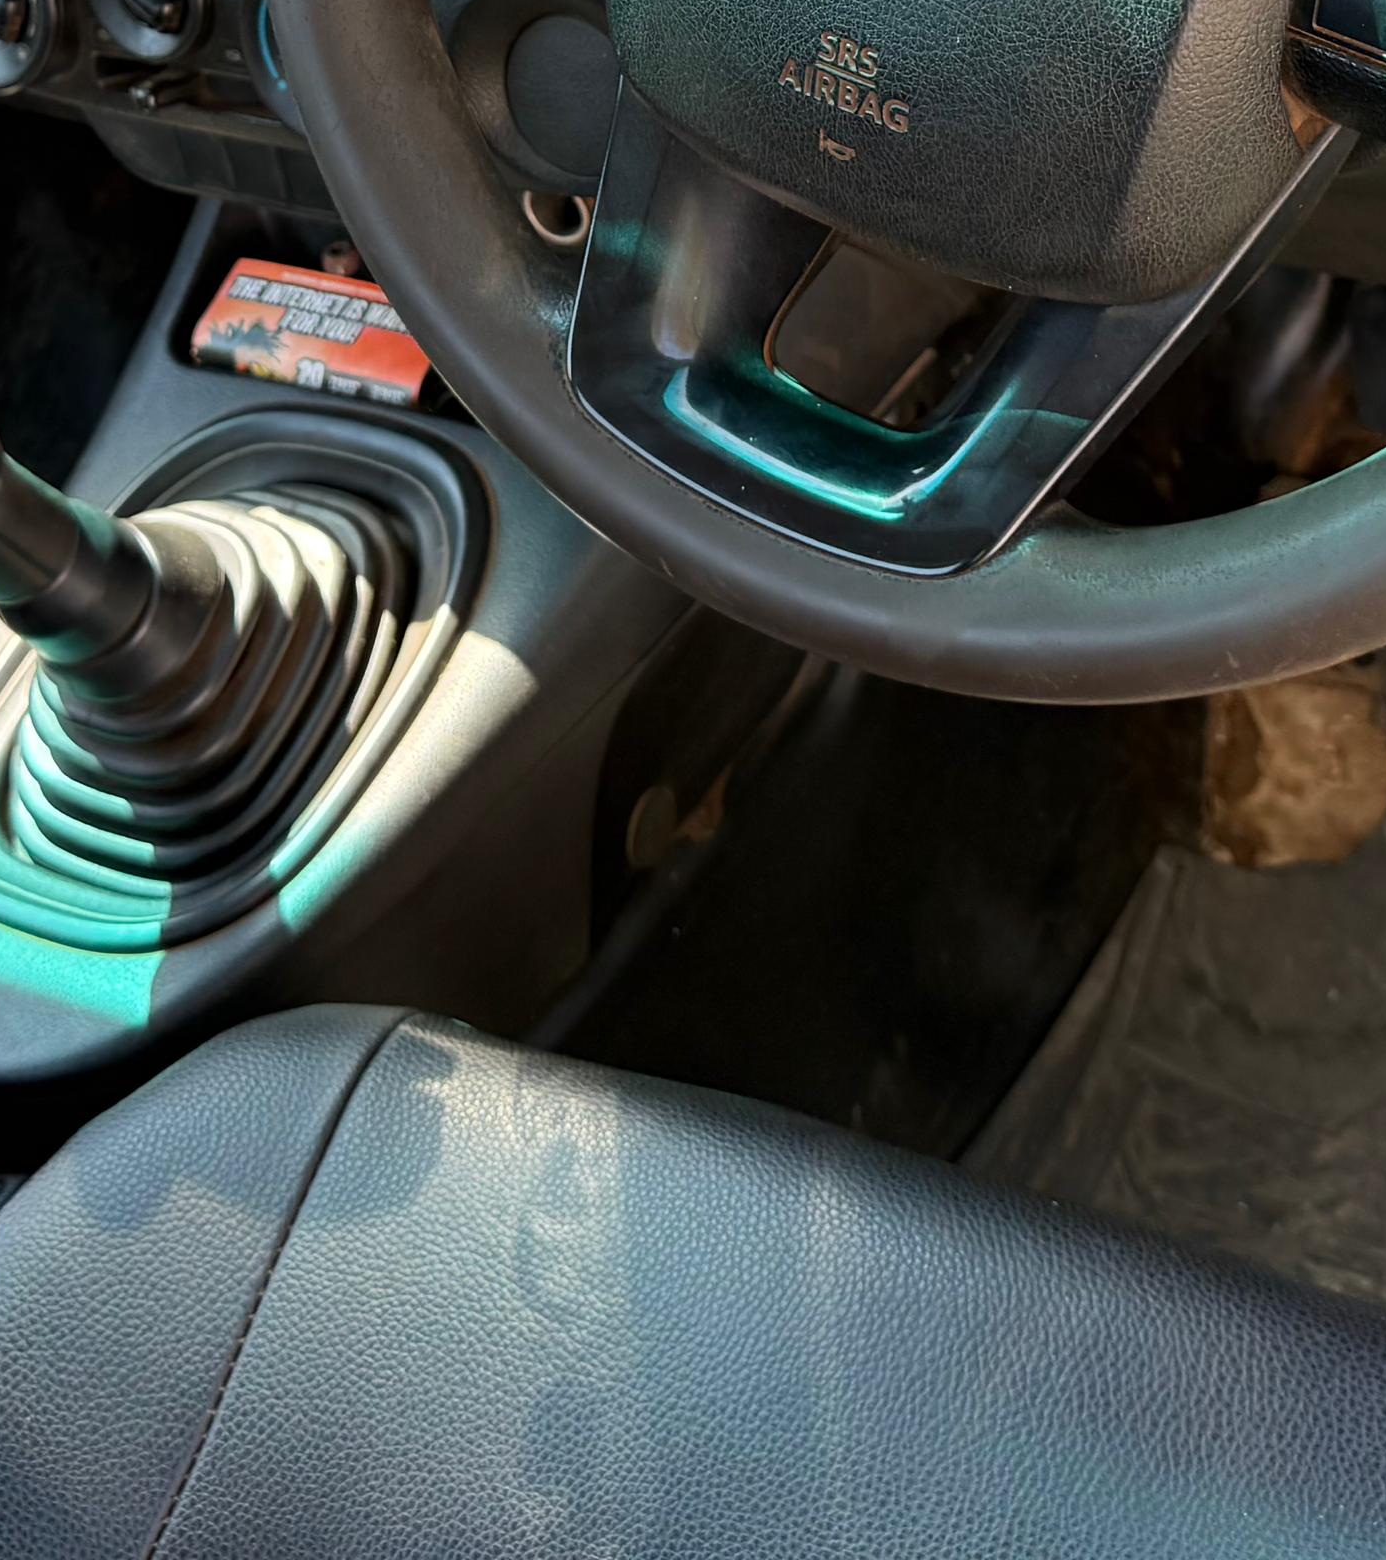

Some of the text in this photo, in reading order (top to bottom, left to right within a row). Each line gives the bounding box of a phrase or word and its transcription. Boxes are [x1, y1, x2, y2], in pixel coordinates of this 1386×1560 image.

[817, 31, 878, 77] SRS
[778, 58, 910, 133] AIRBAG
[229, 276, 266, 299] THE
[262, 282, 351, 316] INTERNET
[342, 299, 368, 321] IS
[280, 308, 321, 336] FOR
